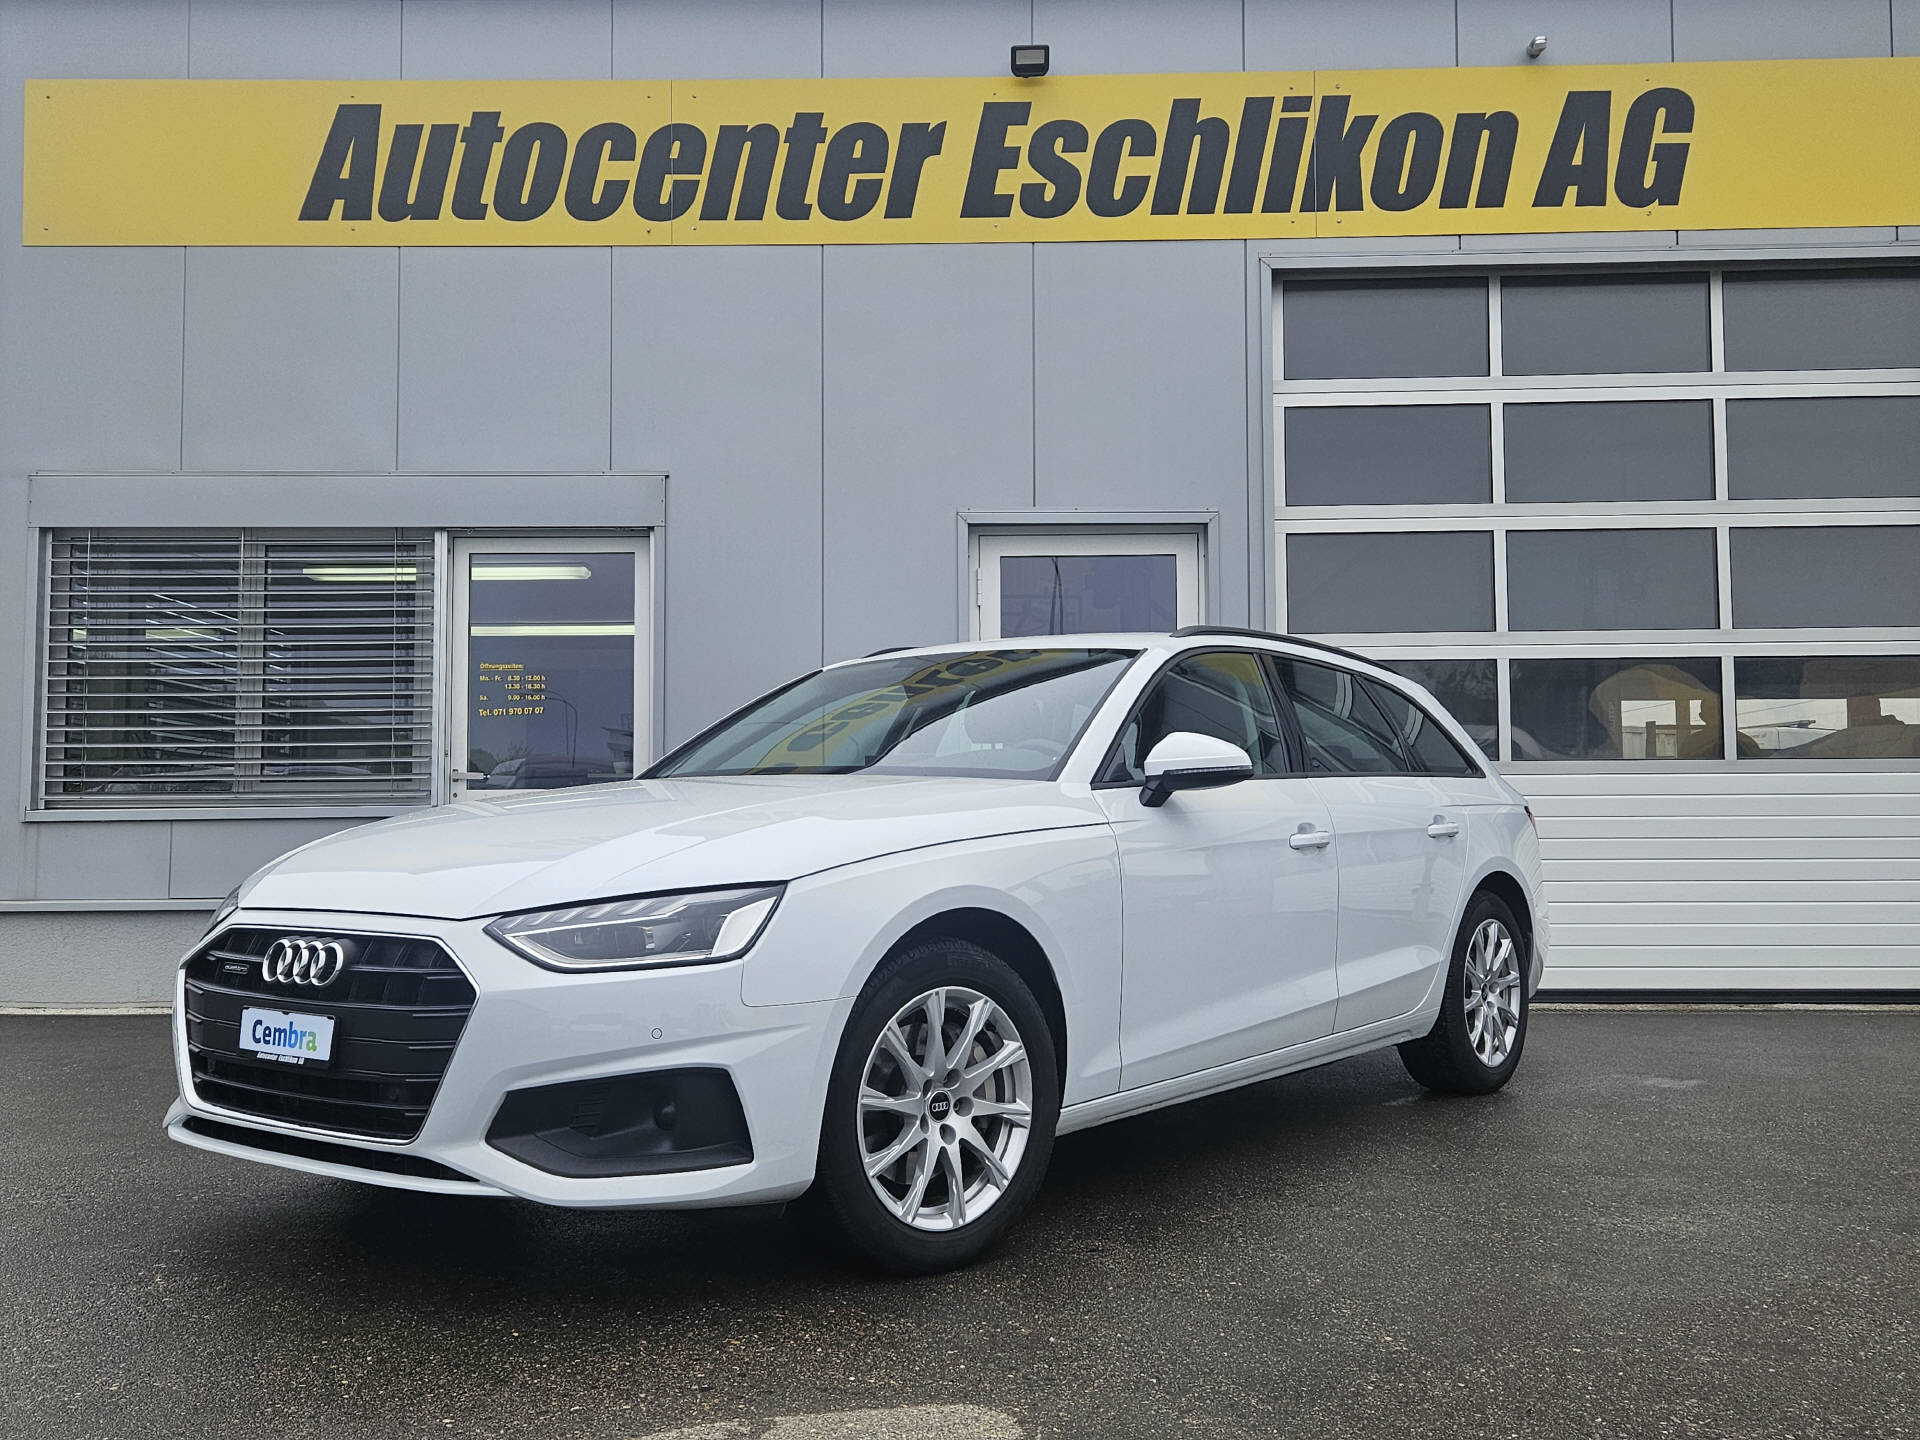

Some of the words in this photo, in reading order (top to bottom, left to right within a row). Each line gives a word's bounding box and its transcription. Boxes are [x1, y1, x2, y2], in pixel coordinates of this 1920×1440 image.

[298, 102, 947, 222] Autocenter
[960, 94, 1518, 219] Eschlikon
[1531, 87, 1695, 208] AG
[478, 708, 492, 717] Tel.
[493, 708, 506, 717] 071
[508, 707, 523, 716] 970
[524, 707, 533, 715] 07
[534, 706, 544, 715] 07
[252, 1019, 318, 1052] Cembra
